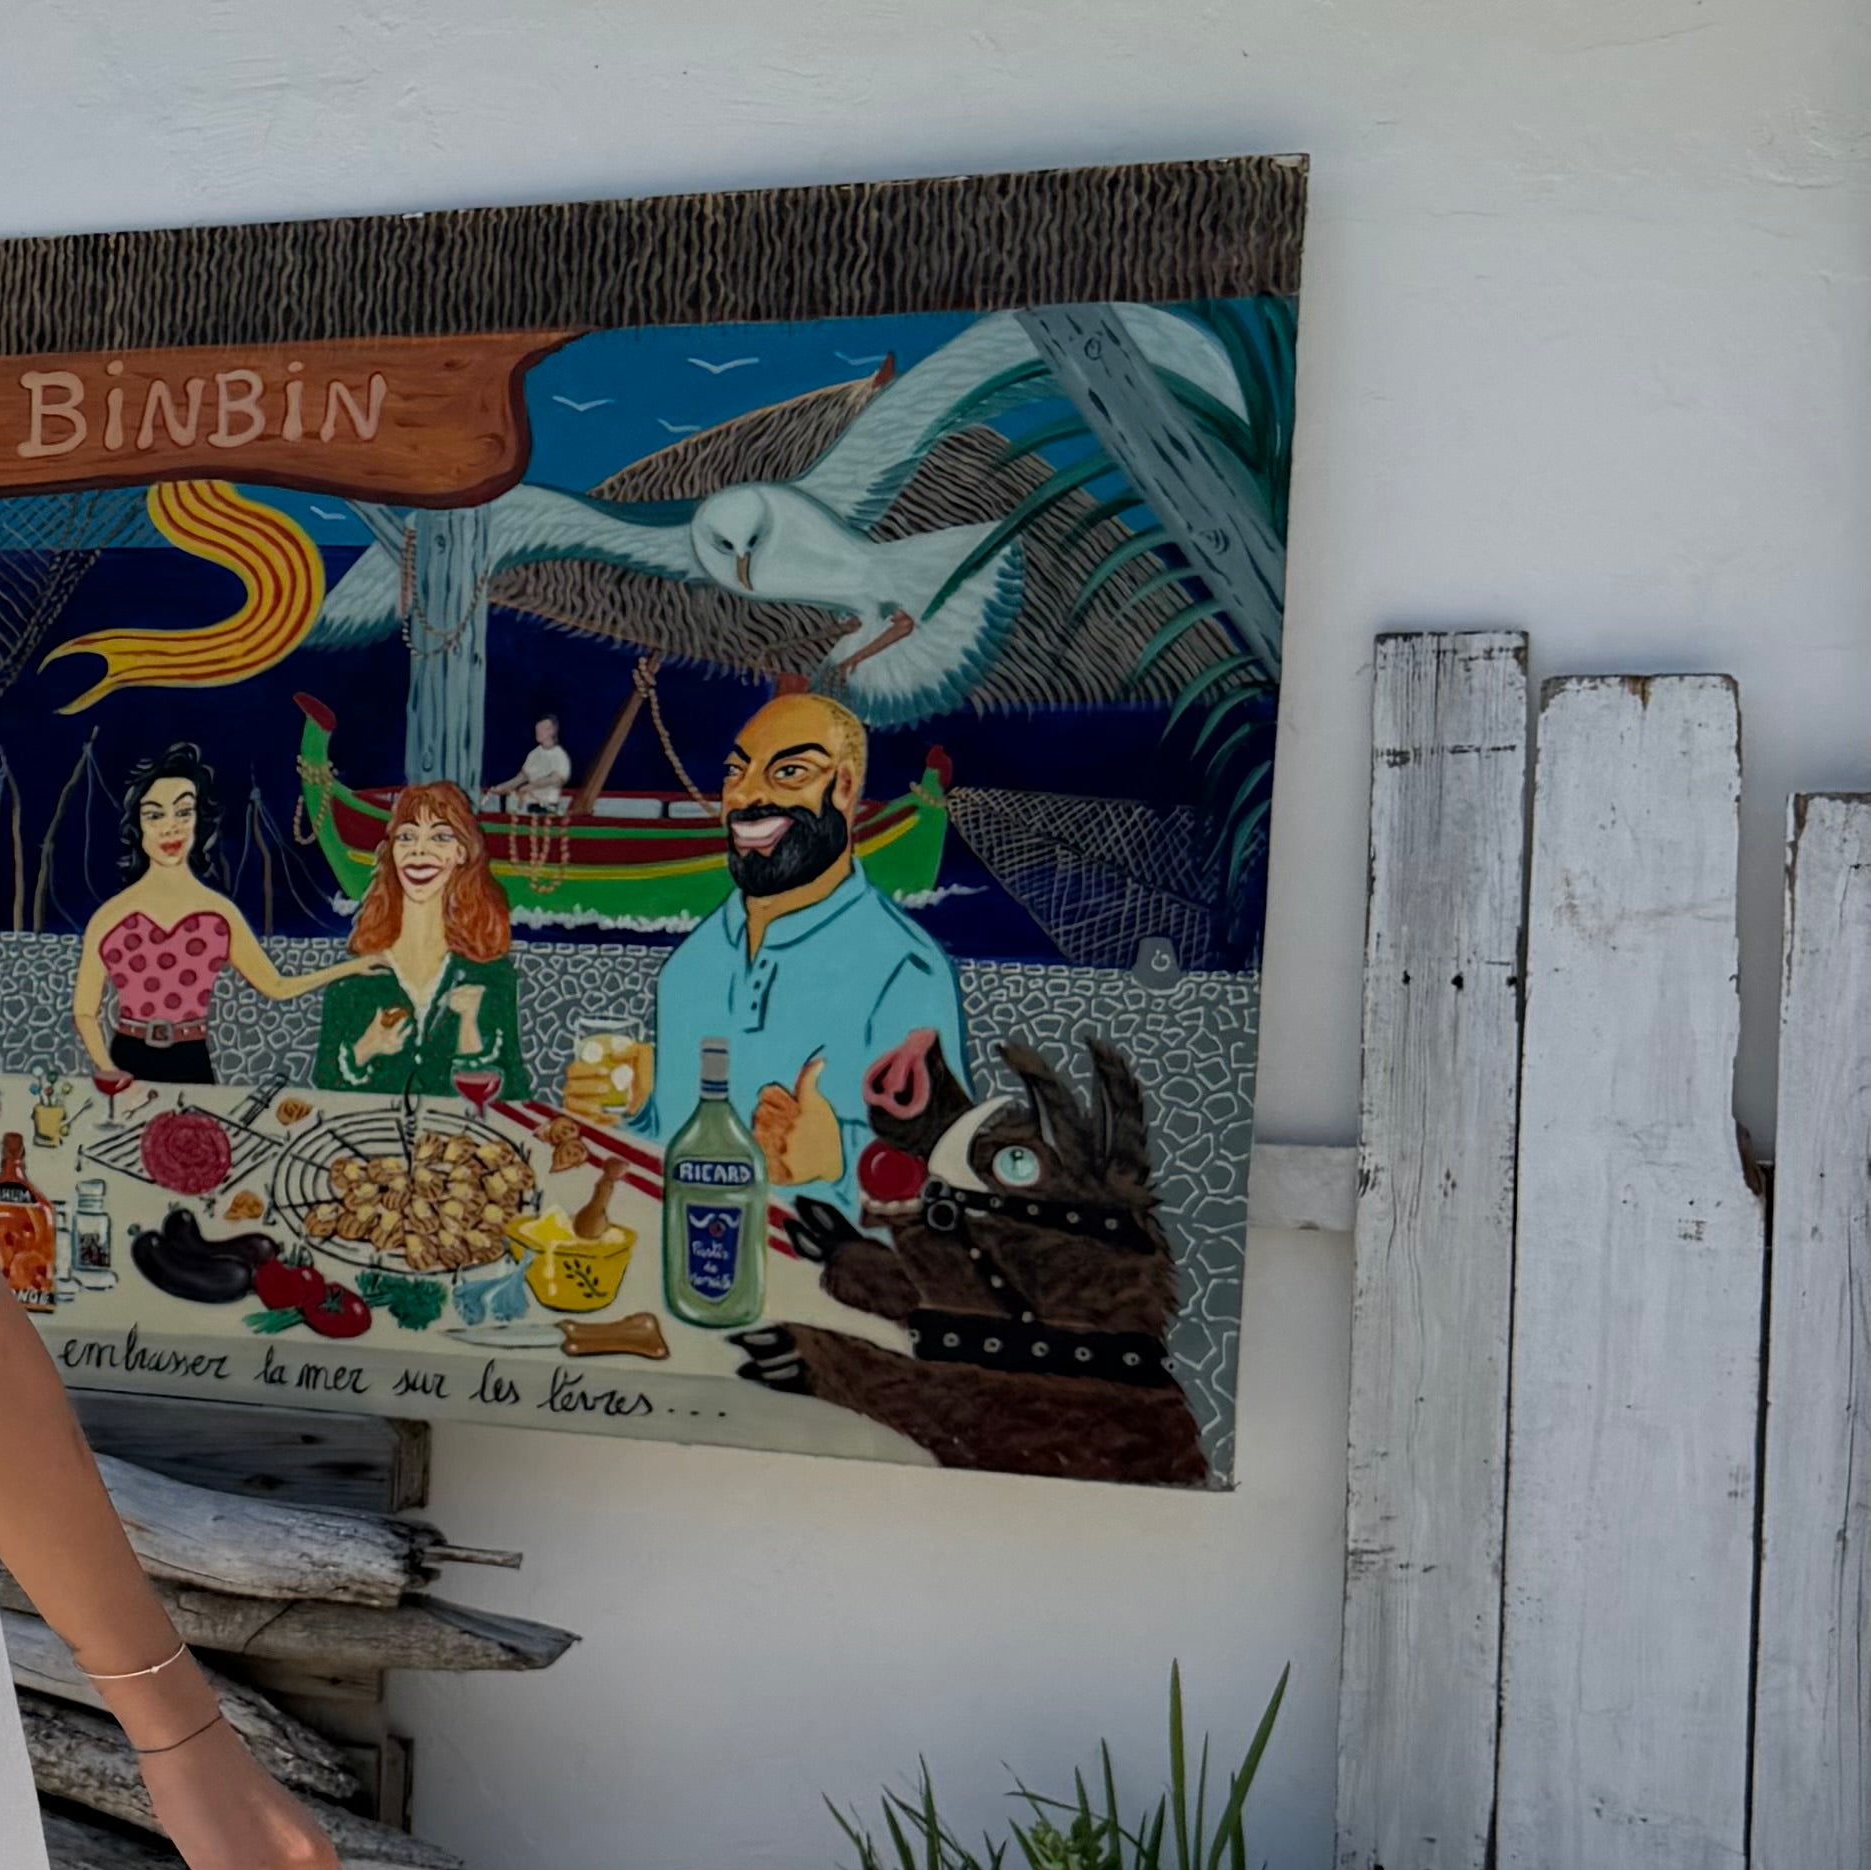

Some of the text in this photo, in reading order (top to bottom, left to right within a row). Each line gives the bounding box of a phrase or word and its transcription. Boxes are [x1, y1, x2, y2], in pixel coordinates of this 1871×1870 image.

[679, 1161, 751, 1183] RICARD
[58, 1321, 231, 1379] embrasser
[254, 1345, 288, 1386] la
[296, 1363, 372, 1394] mer
[392, 1367, 452, 1398] sur
[469, 1359, 520, 1404] les
